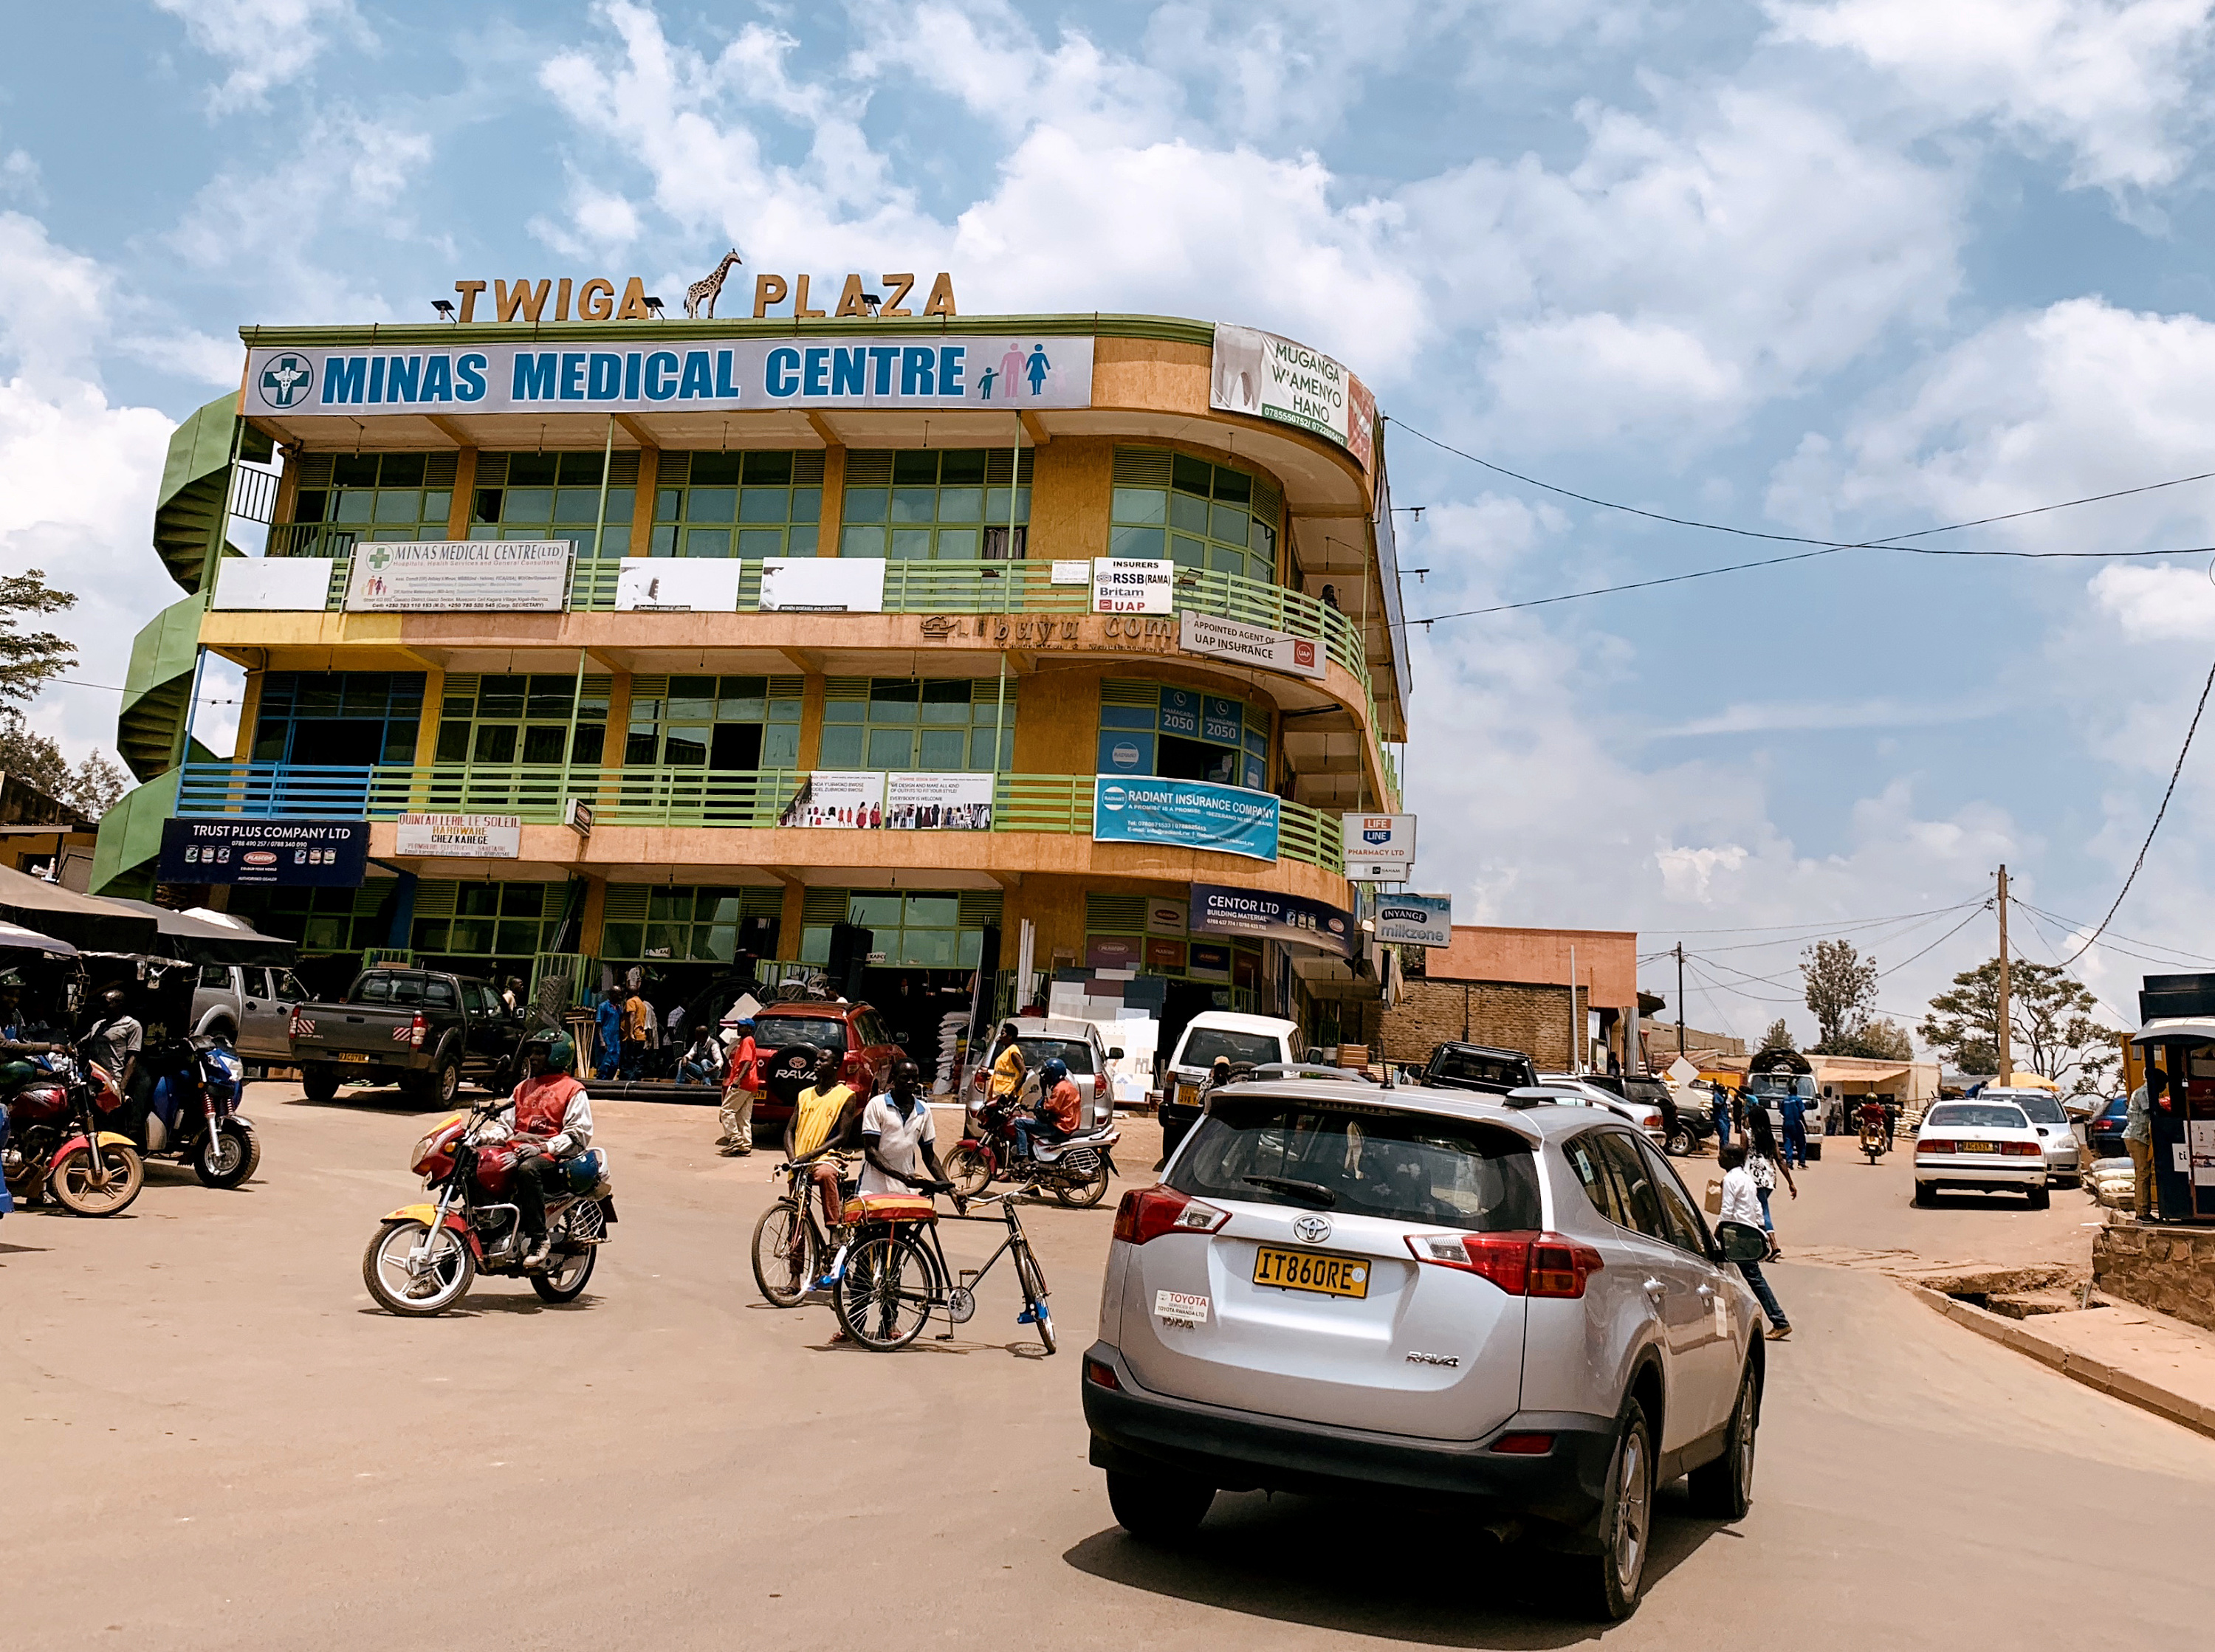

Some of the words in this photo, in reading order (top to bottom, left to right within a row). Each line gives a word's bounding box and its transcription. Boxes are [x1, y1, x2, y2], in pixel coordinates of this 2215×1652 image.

[454, 276, 649, 323] TWIGA
[753, 272, 956, 318] PLAZA
[1275, 343, 1340, 385] MUGANGA
[321, 353, 488, 405] MINAS
[511, 345, 740, 402] MEDICAL
[765, 345, 966, 398] CENTRE
[1272, 365, 1342, 407] W'AMENYO
[1293, 396, 1330, 423] HANO
[394, 546, 436, 560] MINAS
[439, 545, 490, 560] MEDICAL
[1113, 573, 1171, 586] RSSB(RAMA)
[1099, 587, 1144, 596] Britam
[1114, 602, 1145, 611] UAP
[1194, 621, 1237, 636] APPOINTED
[1238, 630, 1263, 642] AGENT
[1195, 633, 1216, 645] UAP
[1218, 639, 1274, 659] INSURANCE
[1164, 714, 1194, 731] 2050
[1206, 723, 1236, 739] 2050
[1128, 790, 1174, 804] RADIANT
[1175, 794, 1232, 811] INSURANCE
[1232, 802, 1275, 819] COMPANY
[468, 816, 484, 826] LE
[484, 816, 520, 828] SOLEIL
[1367, 819, 1387, 828] LIFE
[193, 825, 230, 836] TRUST
[232, 826, 261, 837] PLUS
[264, 827, 326, 839] COMPANY
[329, 827, 351, 839] LTD
[433, 826, 487, 835] HARDWARE
[1367, 832, 1387, 841] LINE
[431, 834, 453, 843] CHEZ
[1208, 895, 1257, 912] CENTOR
[1260, 901, 1280, 915] LTD
[1206, 909, 1237, 918] BUILDING
[1237, 913, 1266, 922] MATERIAL
[1384, 910, 1425, 922] INYANGE
[1381, 924, 1444, 941] milkzone
[775, 1069, 818, 1081] RAV4
[1259, 1253, 1353, 1290] IT860RE
[1170, 1293, 1207, 1307] TOYOTA
[1406, 1351, 1460, 1367] RAV4
